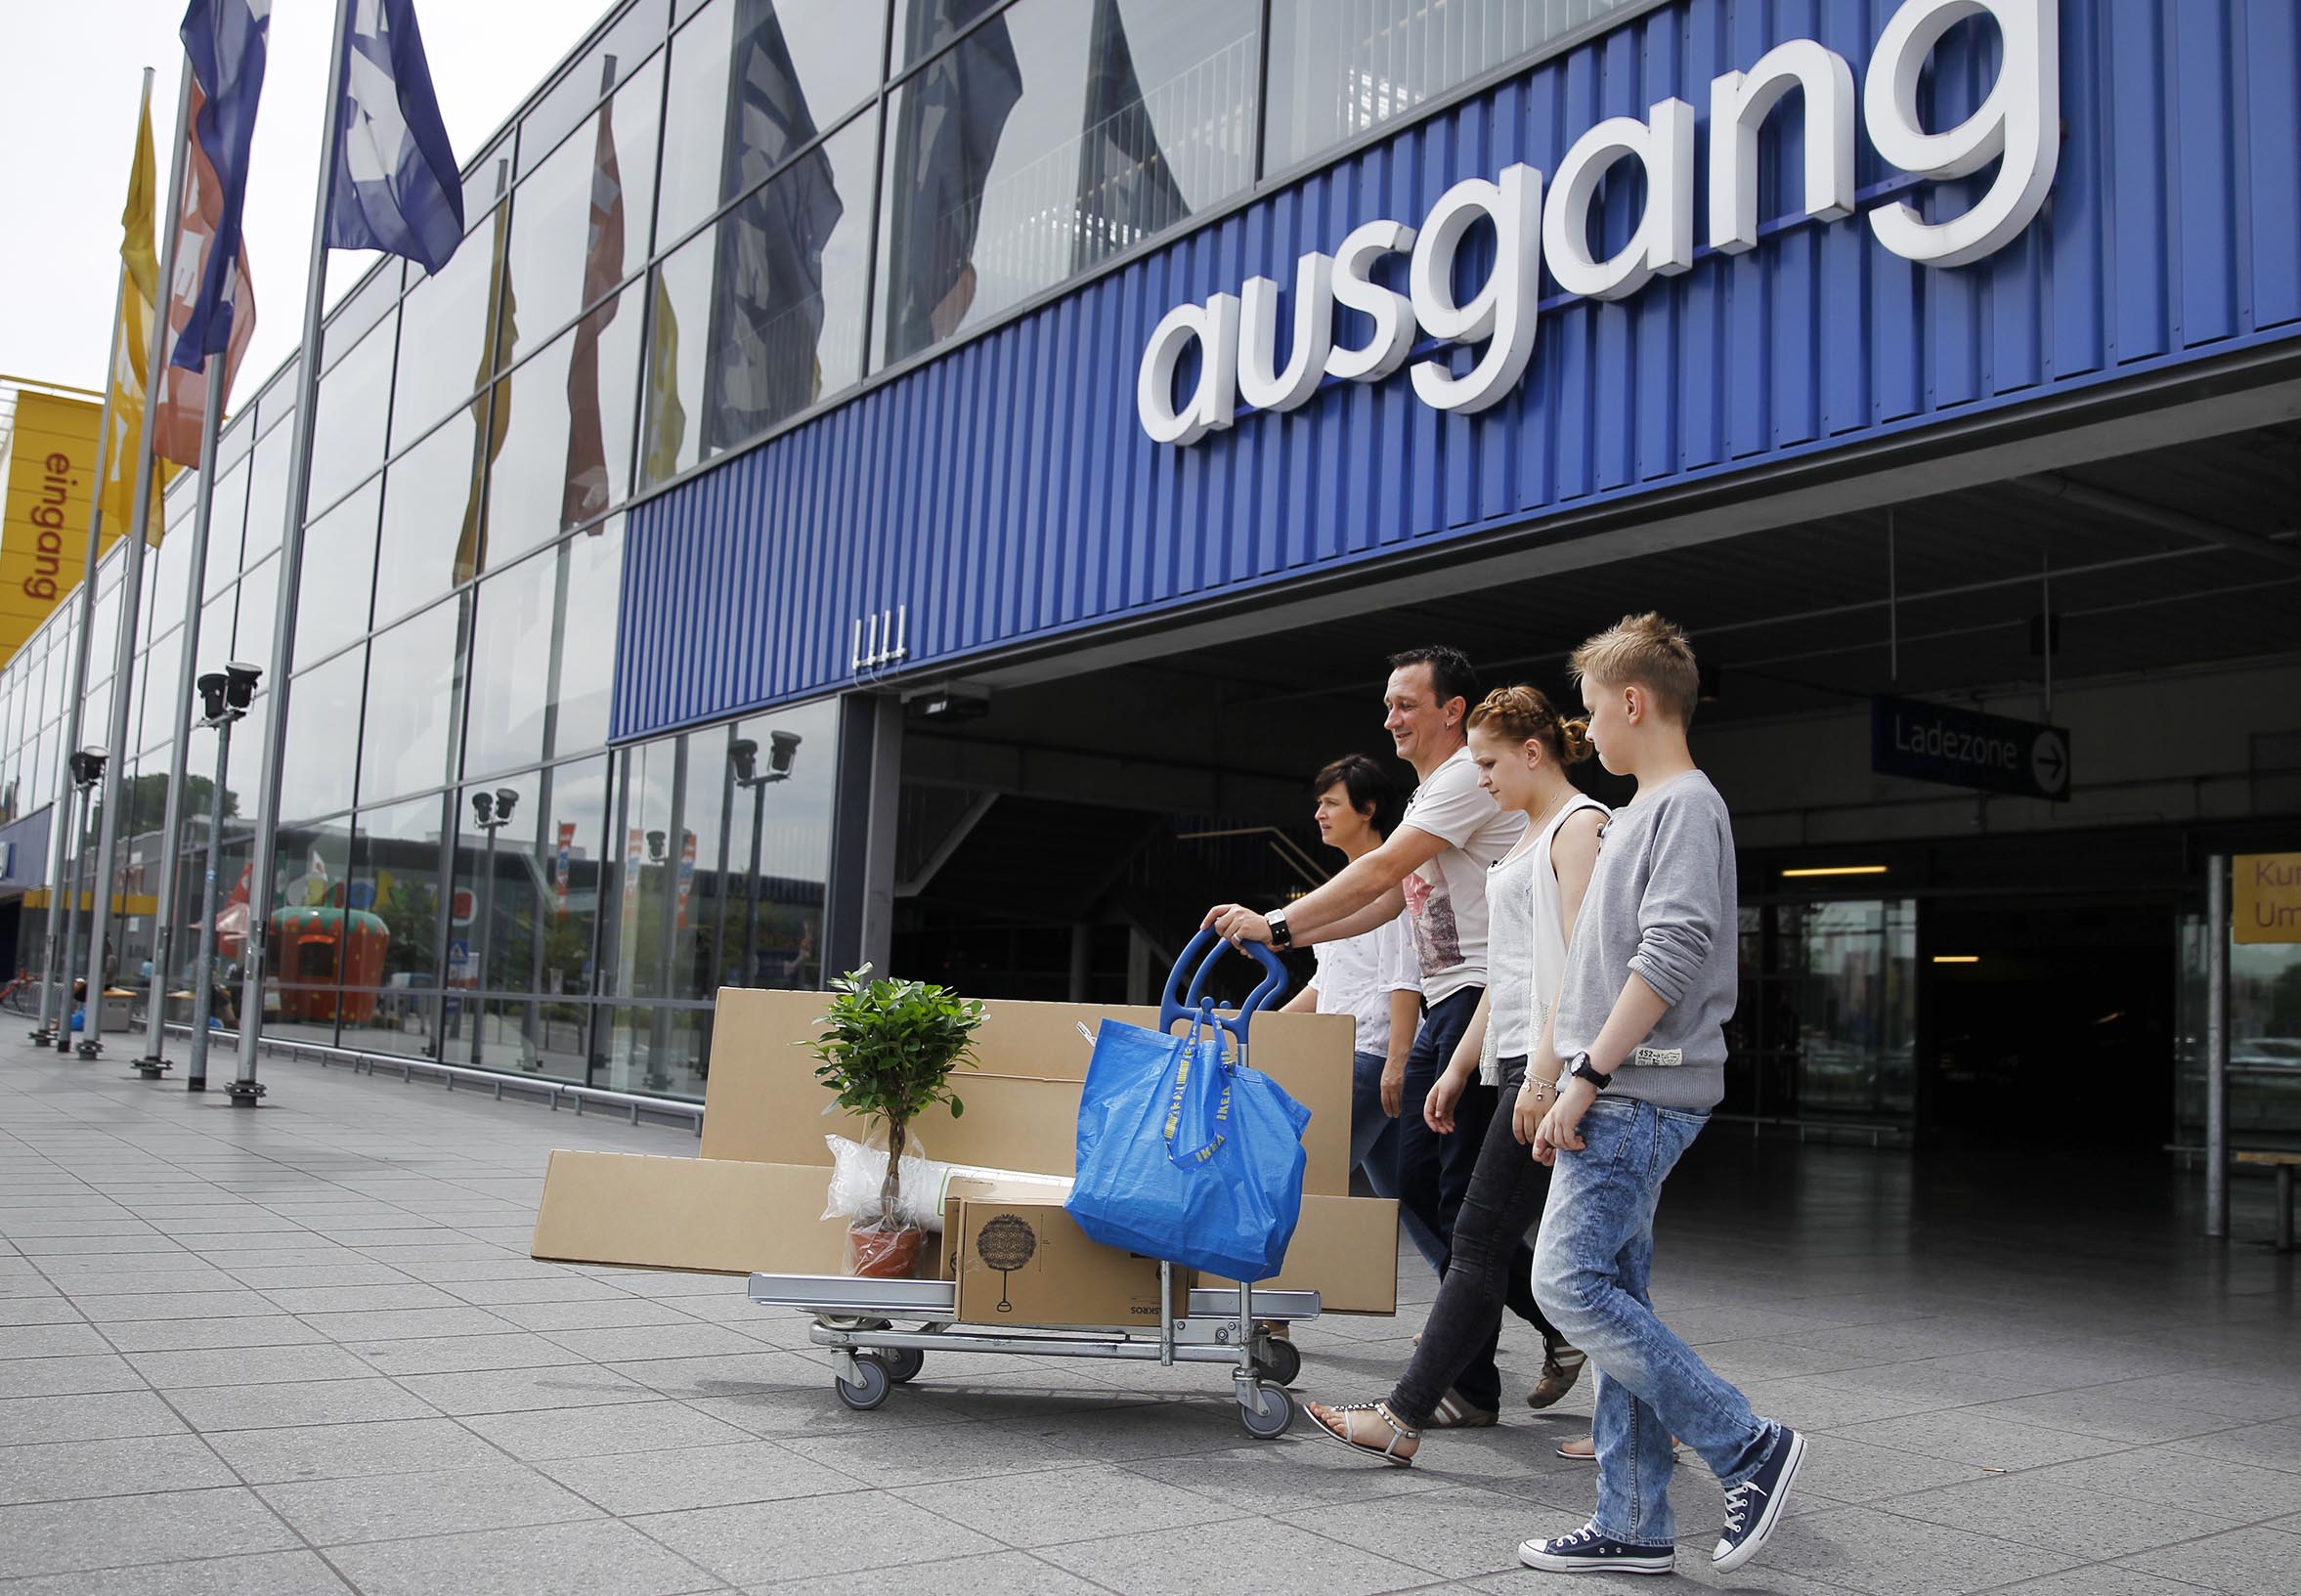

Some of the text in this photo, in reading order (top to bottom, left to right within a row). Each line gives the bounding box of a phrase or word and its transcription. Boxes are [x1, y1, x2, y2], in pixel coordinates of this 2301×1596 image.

[1138, 0, 2061, 447] ausgang
[23, 452, 78, 601] eingang
[1895, 712, 2018, 769] Ladezone
[1216, 1086, 1231, 1121] IKEA
[1194, 1134, 1226, 1163] IKEA
[1130, 1306, 1162, 1315] SKROS
